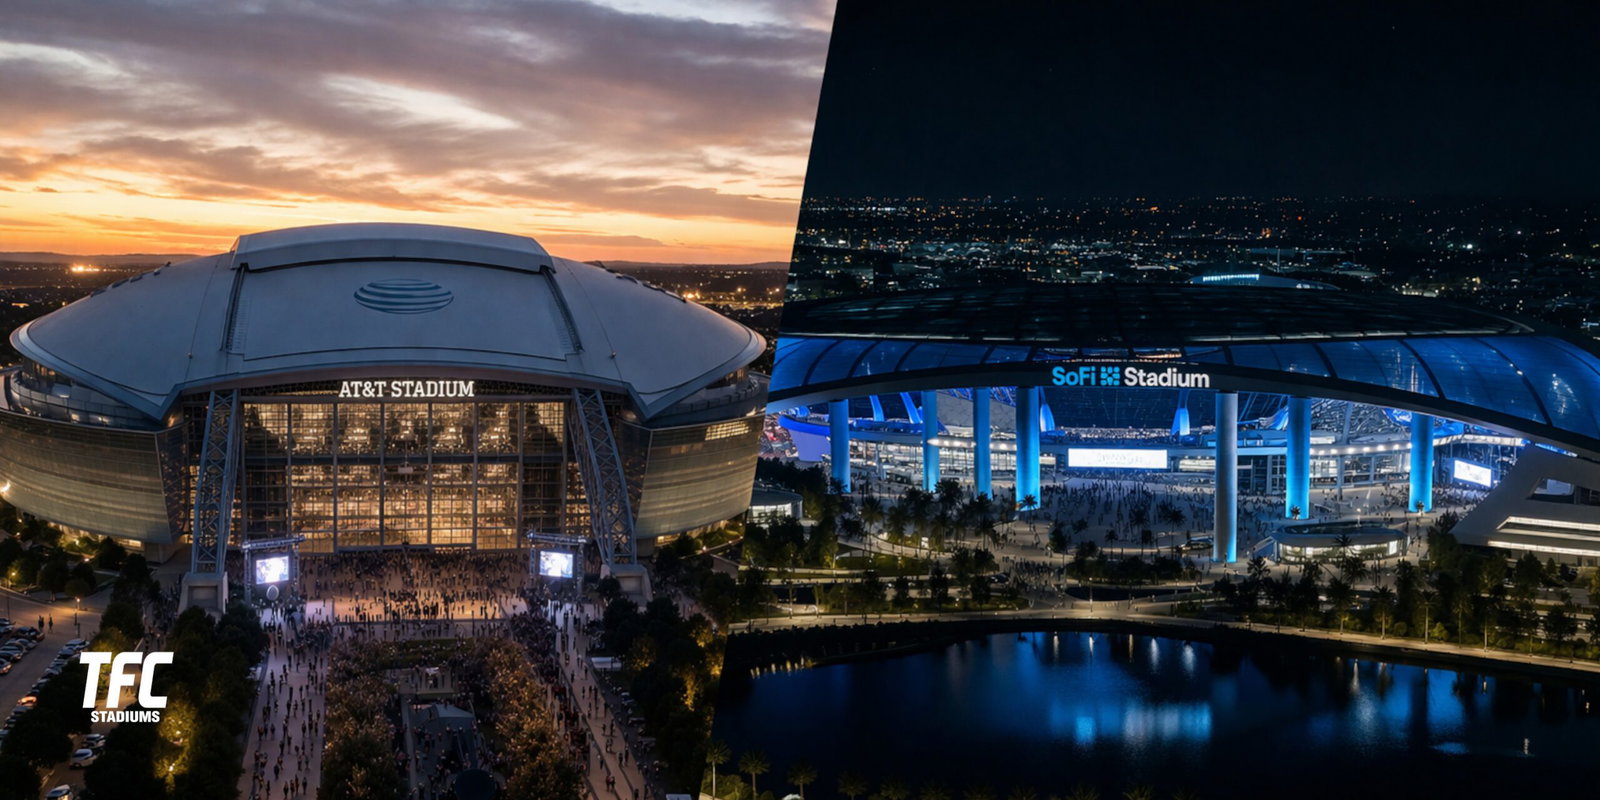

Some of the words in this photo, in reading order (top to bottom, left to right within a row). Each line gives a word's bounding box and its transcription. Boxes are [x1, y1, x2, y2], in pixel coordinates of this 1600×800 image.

[1052, 366, 1096, 386] SoFi
[1124, 366, 1210, 388] Stadium
[338, 381, 387, 398] AT&T
[391, 380, 475, 398] STADIUM
